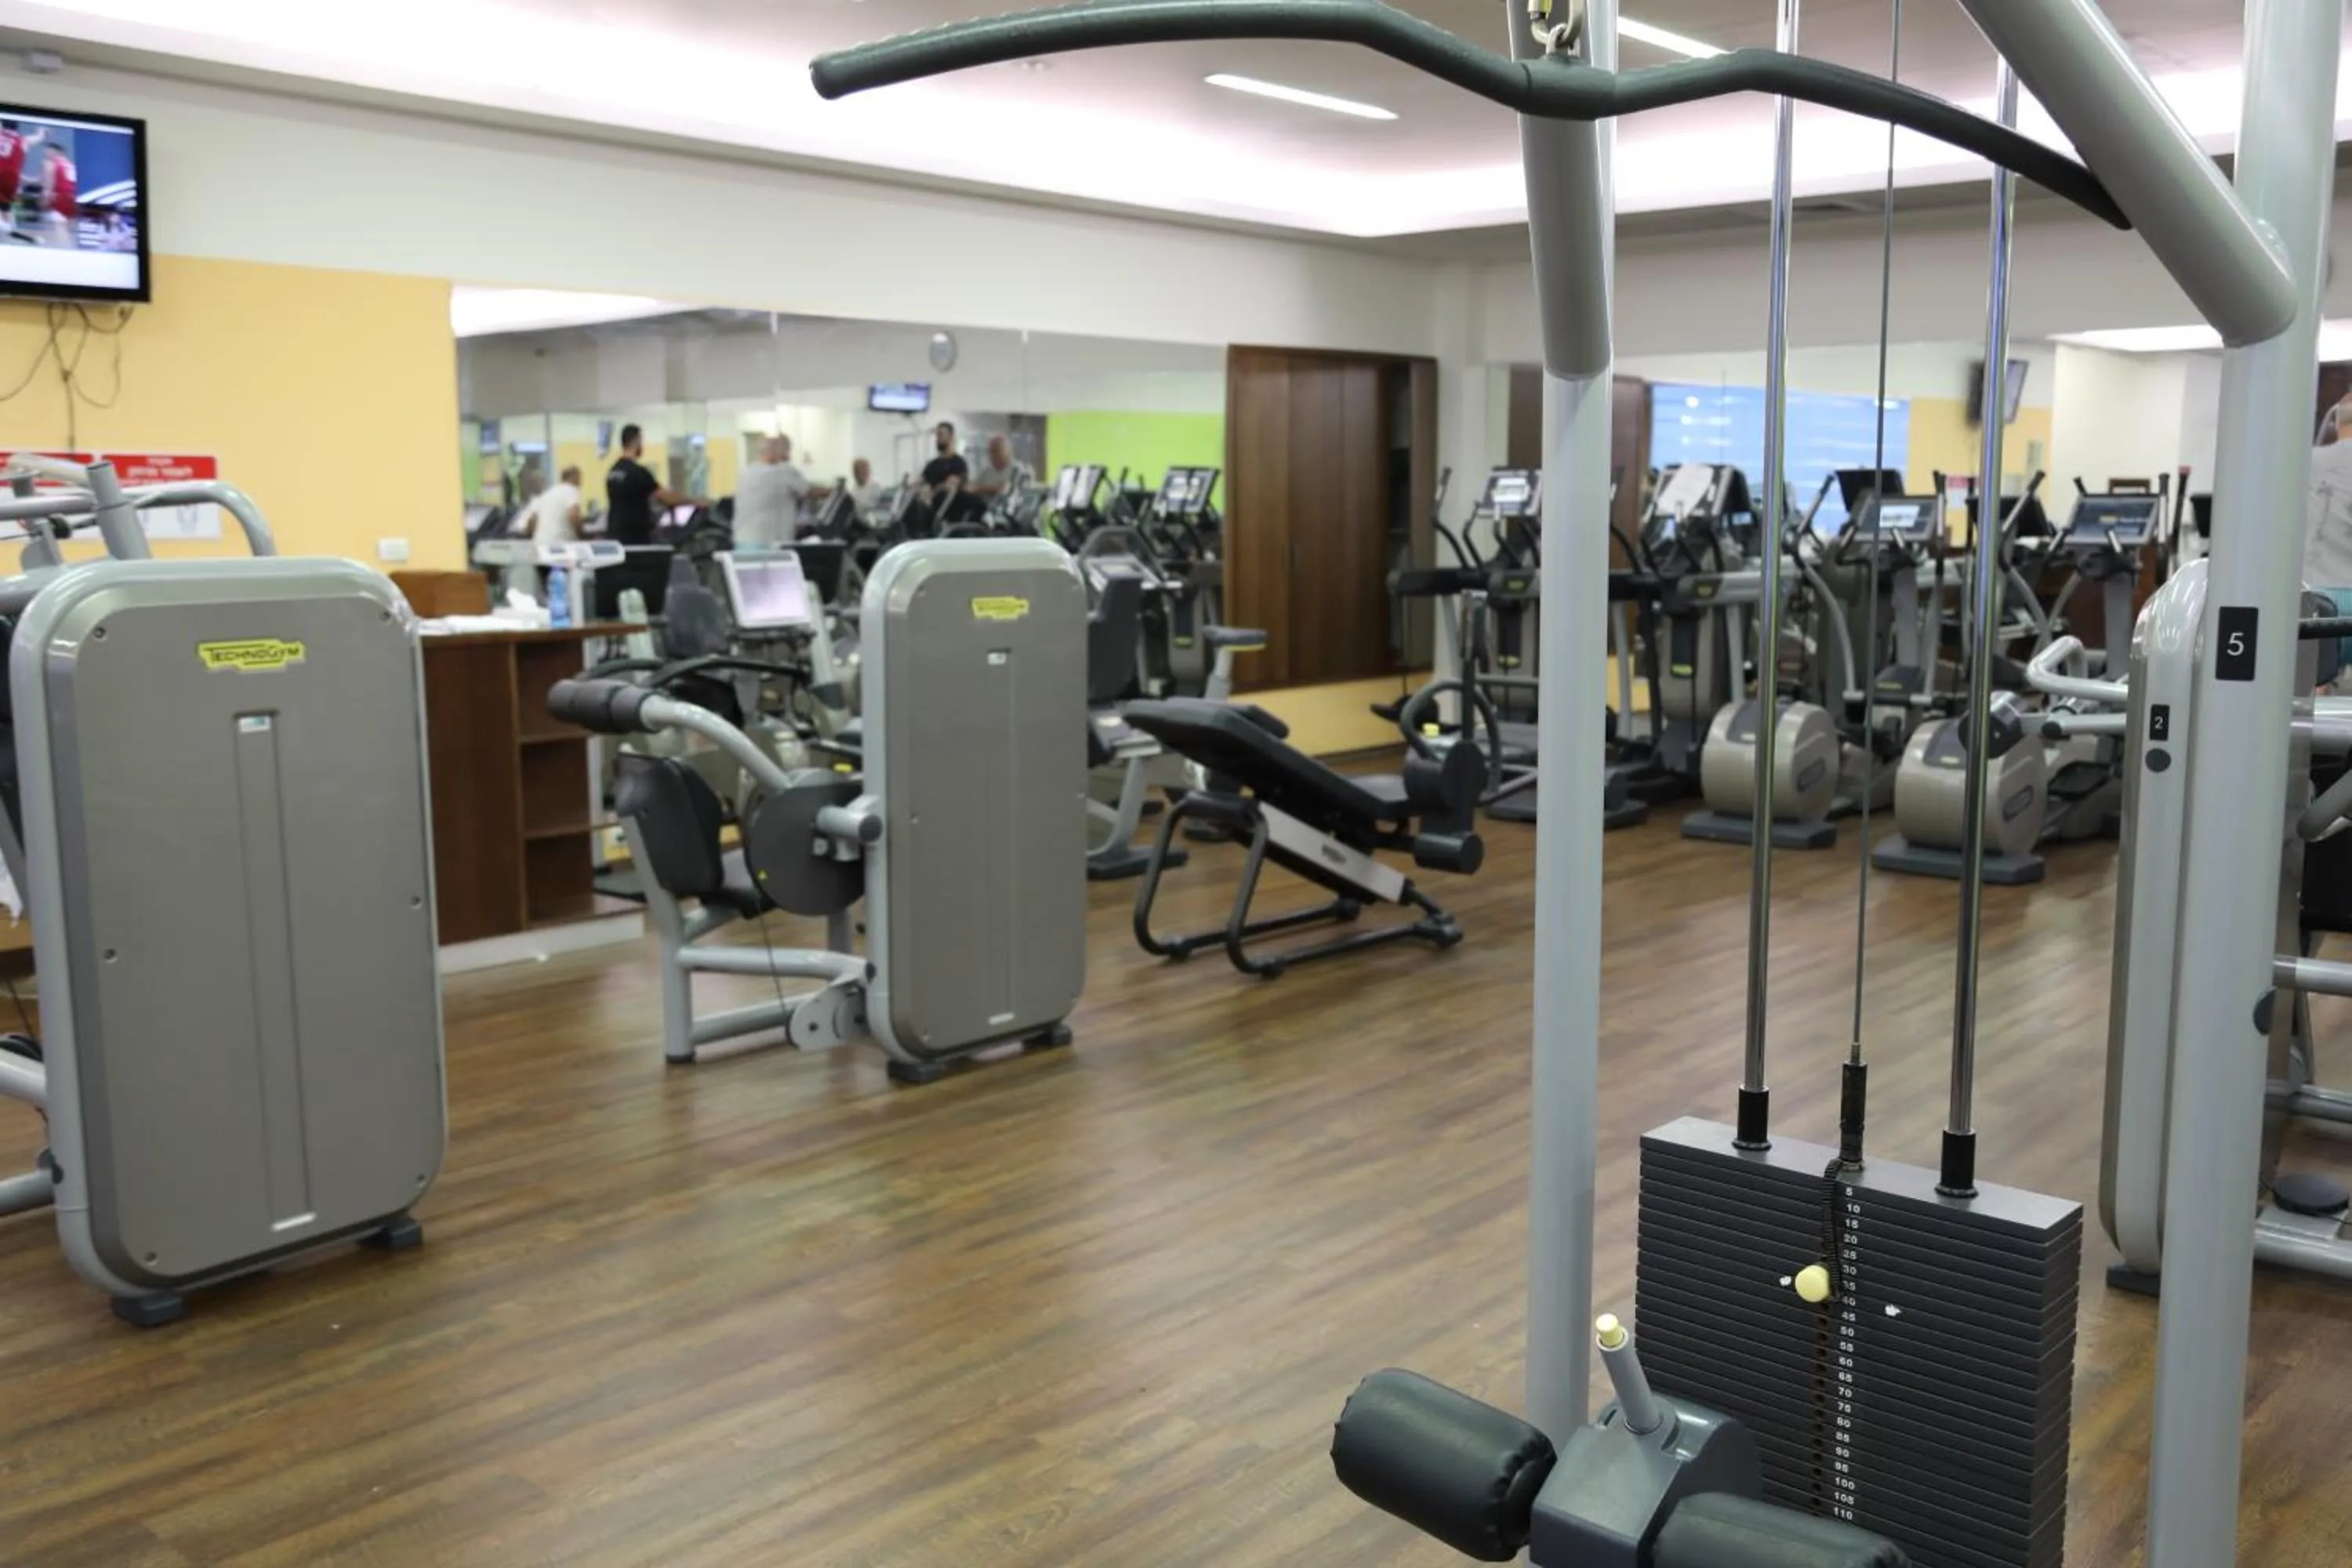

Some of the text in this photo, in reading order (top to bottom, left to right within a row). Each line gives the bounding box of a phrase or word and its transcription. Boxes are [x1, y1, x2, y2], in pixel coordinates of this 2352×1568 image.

[2227, 632, 2245, 656] 5
[2154, 716, 2164, 730] 2
[1845, 1186, 1853, 1196] 5
[1846, 1203, 1860, 1214] 10
[1846, 1218, 1859, 1229] 15
[1844, 1234, 1857, 1244] 20
[1844, 1250, 1857, 1260] 25
[1843, 1265, 1857, 1275] 30
[1842, 1311, 1856, 1321] 45
[1840, 1326, 1854, 1337] 50
[1839, 1341, 1853, 1352] 55
[1838, 1356, 1853, 1367] 60
[1838, 1372, 1853, 1383] 65
[1838, 1387, 1852, 1398] 70
[1837, 1401, 1851, 1413] 75
[1837, 1417, 1851, 1428] 80
[1835, 1432, 1849, 1443] 85
[1835, 1446, 1849, 1457] 90
[1835, 1461, 1849, 1473] 95
[1835, 1476, 1855, 1490] 100
[1834, 1491, 1854, 1504] 105
[1833, 1506, 1853, 1519] 110
